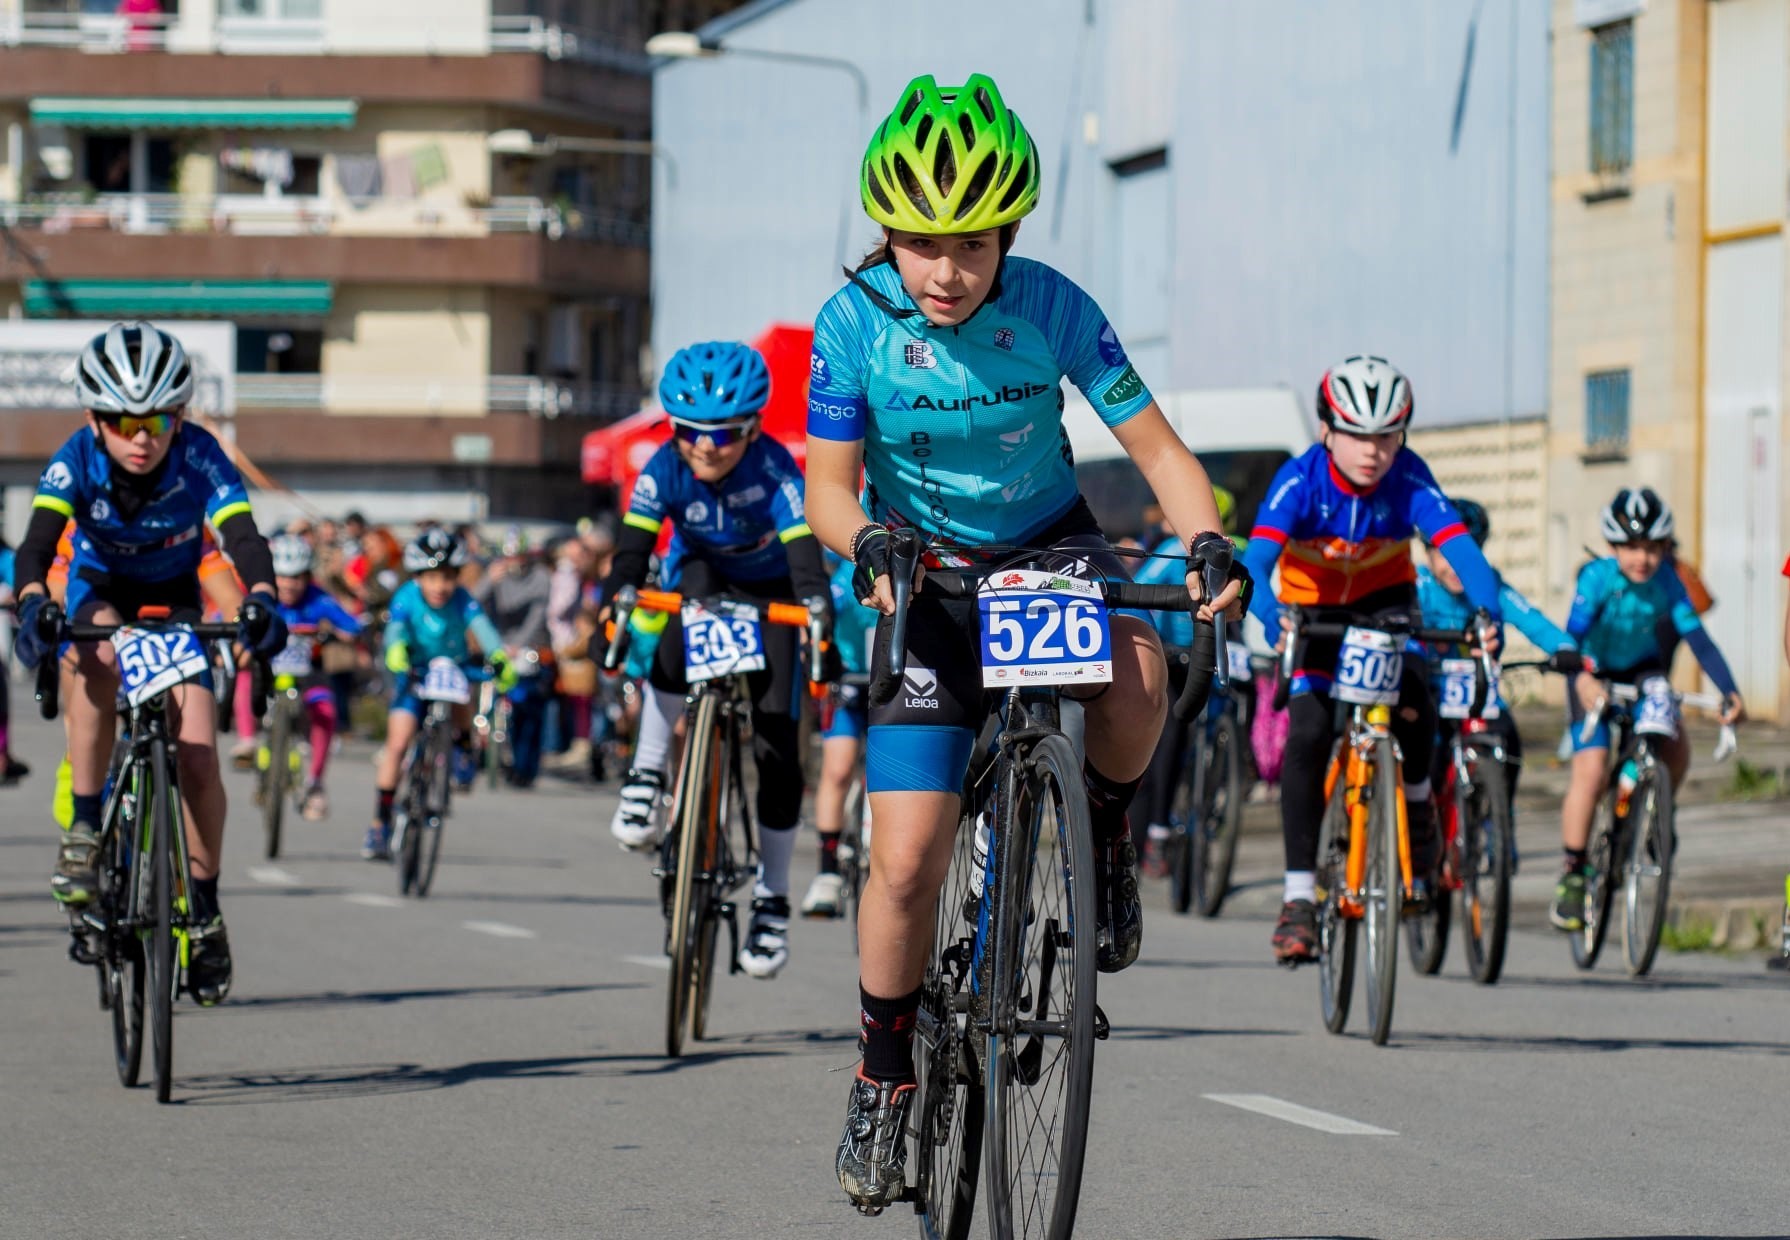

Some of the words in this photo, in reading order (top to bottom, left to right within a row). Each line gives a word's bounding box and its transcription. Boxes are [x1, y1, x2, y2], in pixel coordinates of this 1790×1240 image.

[912, 382, 1049, 411] Aurubis
[687, 620, 758, 664] 503
[988, 598, 1103, 661] 526
[119, 631, 197, 688] 502
[1024, 669, 1048, 677] Bizkaia
[1338, 648, 1403, 691] 509
[904, 697, 939, 709] Leioa
